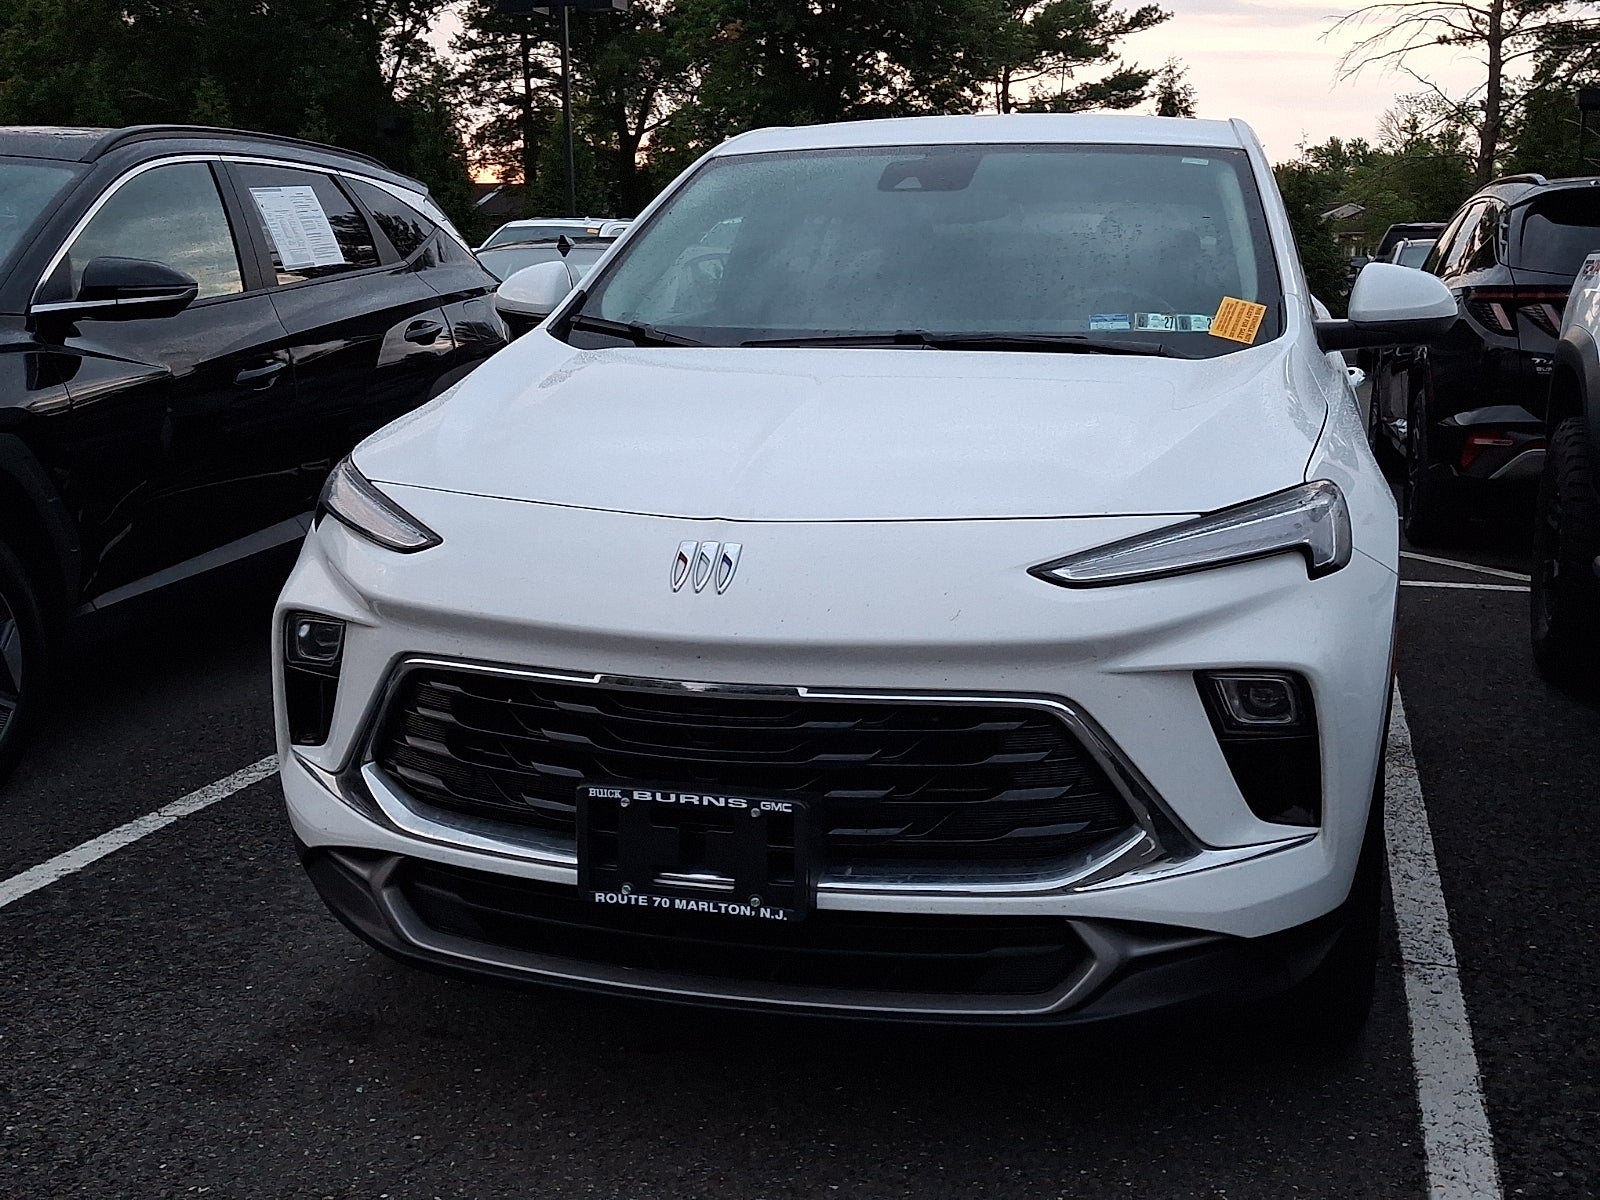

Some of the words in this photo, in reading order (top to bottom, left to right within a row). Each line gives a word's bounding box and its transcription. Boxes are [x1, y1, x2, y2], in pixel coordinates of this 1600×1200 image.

[1244, 304, 1255, 319] READY
[1164, 316, 1174, 329] 27
[1240, 318, 1250, 328] FOR
[1246, 314, 1260, 333] VEHICLE
[1236, 327, 1246, 339] SALE
[588, 787, 622, 799] BUICK
[632, 790, 748, 809] BURNS
[760, 801, 793, 813] GMC
[594, 892, 649, 906] ROUTE
[652, 896, 670, 908] 70
[674, 898, 756, 917] MARLTON,
[759, 907, 788, 921] N.J.
